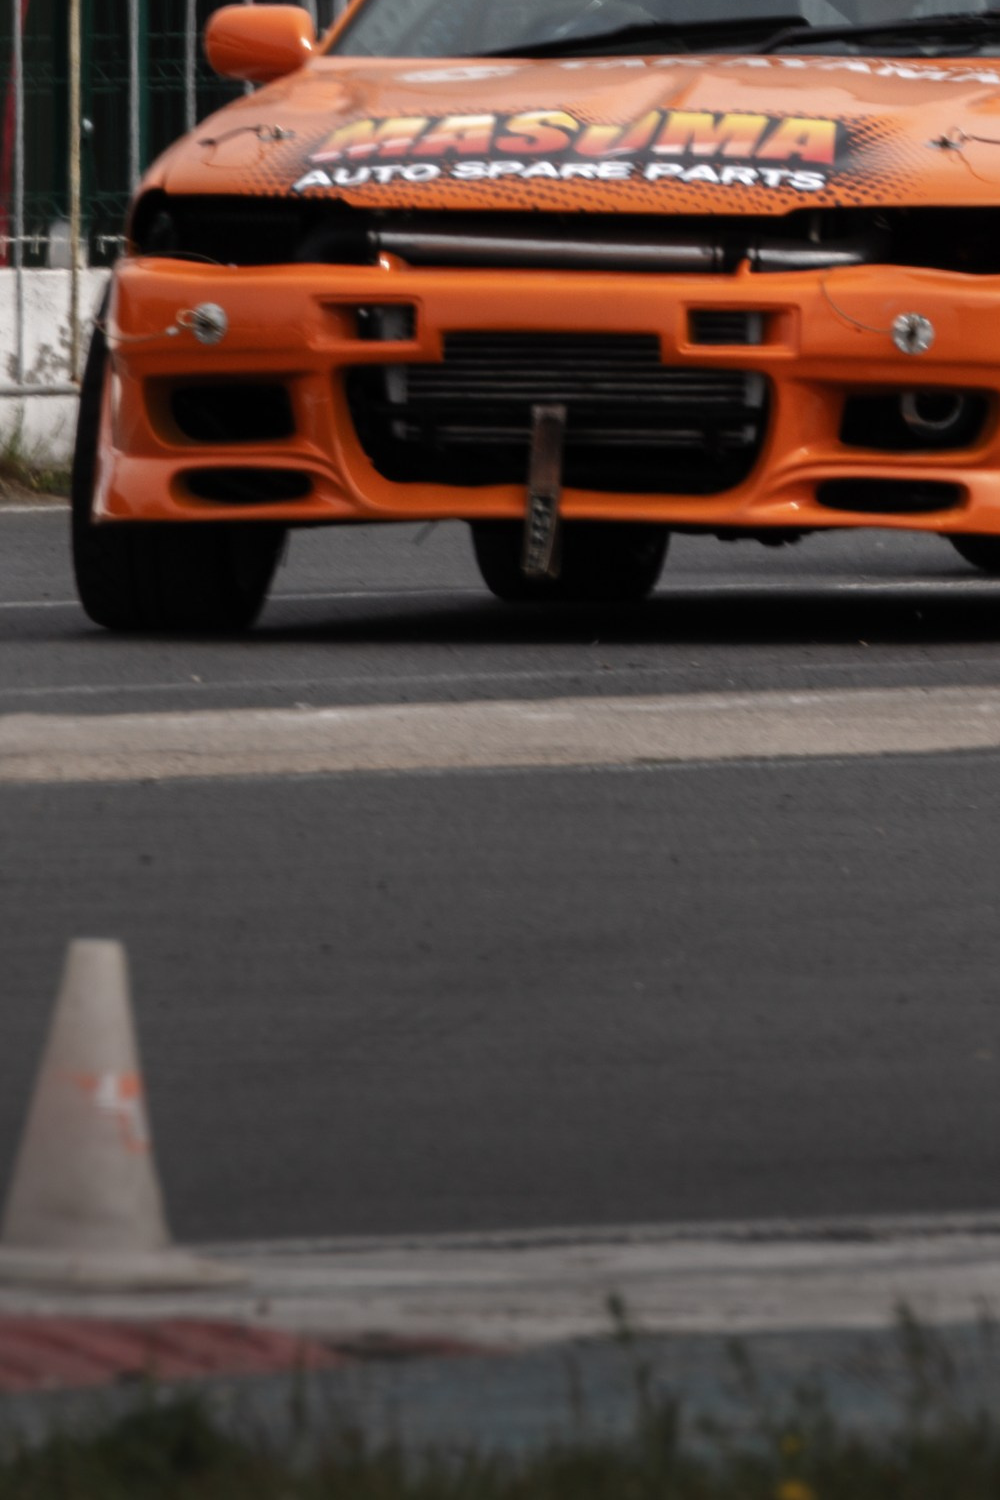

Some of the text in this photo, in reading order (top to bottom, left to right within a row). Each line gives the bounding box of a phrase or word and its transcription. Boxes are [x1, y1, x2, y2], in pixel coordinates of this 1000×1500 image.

[306, 110, 837, 166] MASUMA
[292, 160, 827, 193] AUTO SPARE PARTS
